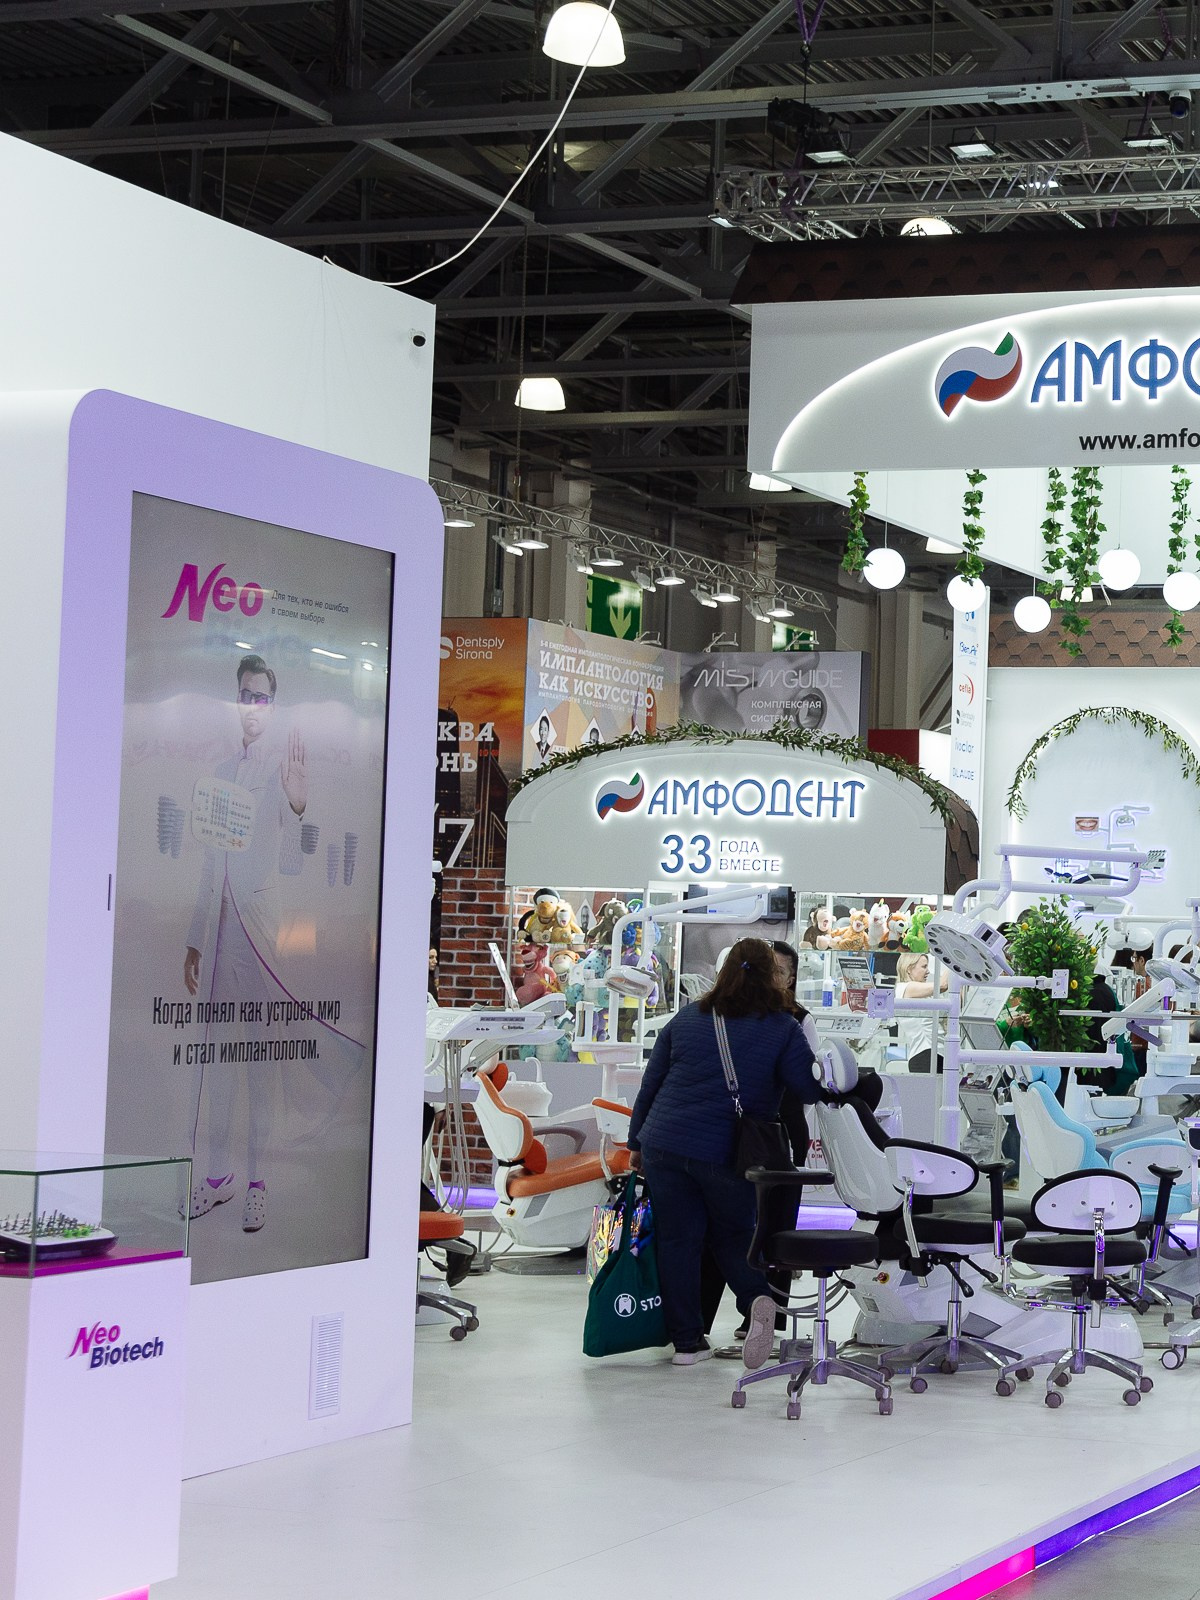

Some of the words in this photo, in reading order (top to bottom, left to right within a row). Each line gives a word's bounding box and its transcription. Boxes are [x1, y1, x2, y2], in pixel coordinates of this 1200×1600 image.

[160, 563, 264, 623] Neo
[271, 589, 286, 601] Для
[287, 594, 300, 605] тех,
[302, 597, 313, 607] кто
[315, 601, 323, 609] не
[324, 602, 350, 614] ошибся
[271, 607, 276, 615] в
[277, 608, 299, 619] своем
[300, 612, 326, 625] выборе
[455, 648, 493, 660] Sirona
[456, 636, 505, 650] Dentsply
[540, 650, 664, 691] ИМПЛАНТОЛОГИЯ
[538, 672, 569, 693] КАК
[574, 678, 654, 709] ИСКУССТВО
[751, 700, 822, 709] КОМПЛЕКСНАЯ
[751, 714, 795, 723] СИСТЕМА
[435, 752, 478, 772] НЬ
[647, 778, 866, 818] АМФОДЕНТ
[660, 834, 712, 874] 33
[720, 840, 760, 855] ГОДА
[719, 858, 780, 872] ВМЕСТЕ
[152, 996, 192, 1029] Когда
[196, 1001, 236, 1024] понял
[239, 1001, 263, 1023] как
[266, 1000, 314, 1027] устроен
[317, 999, 341, 1025] мир
[173, 1043, 181, 1066] и
[185, 1042, 216, 1065] стал
[219, 1039, 320, 1063] имплантологом.
[640, 1295, 662, 1312] STO
[68, 1320, 121, 1358] Neo
[90, 1336, 164, 1369] Biotech
